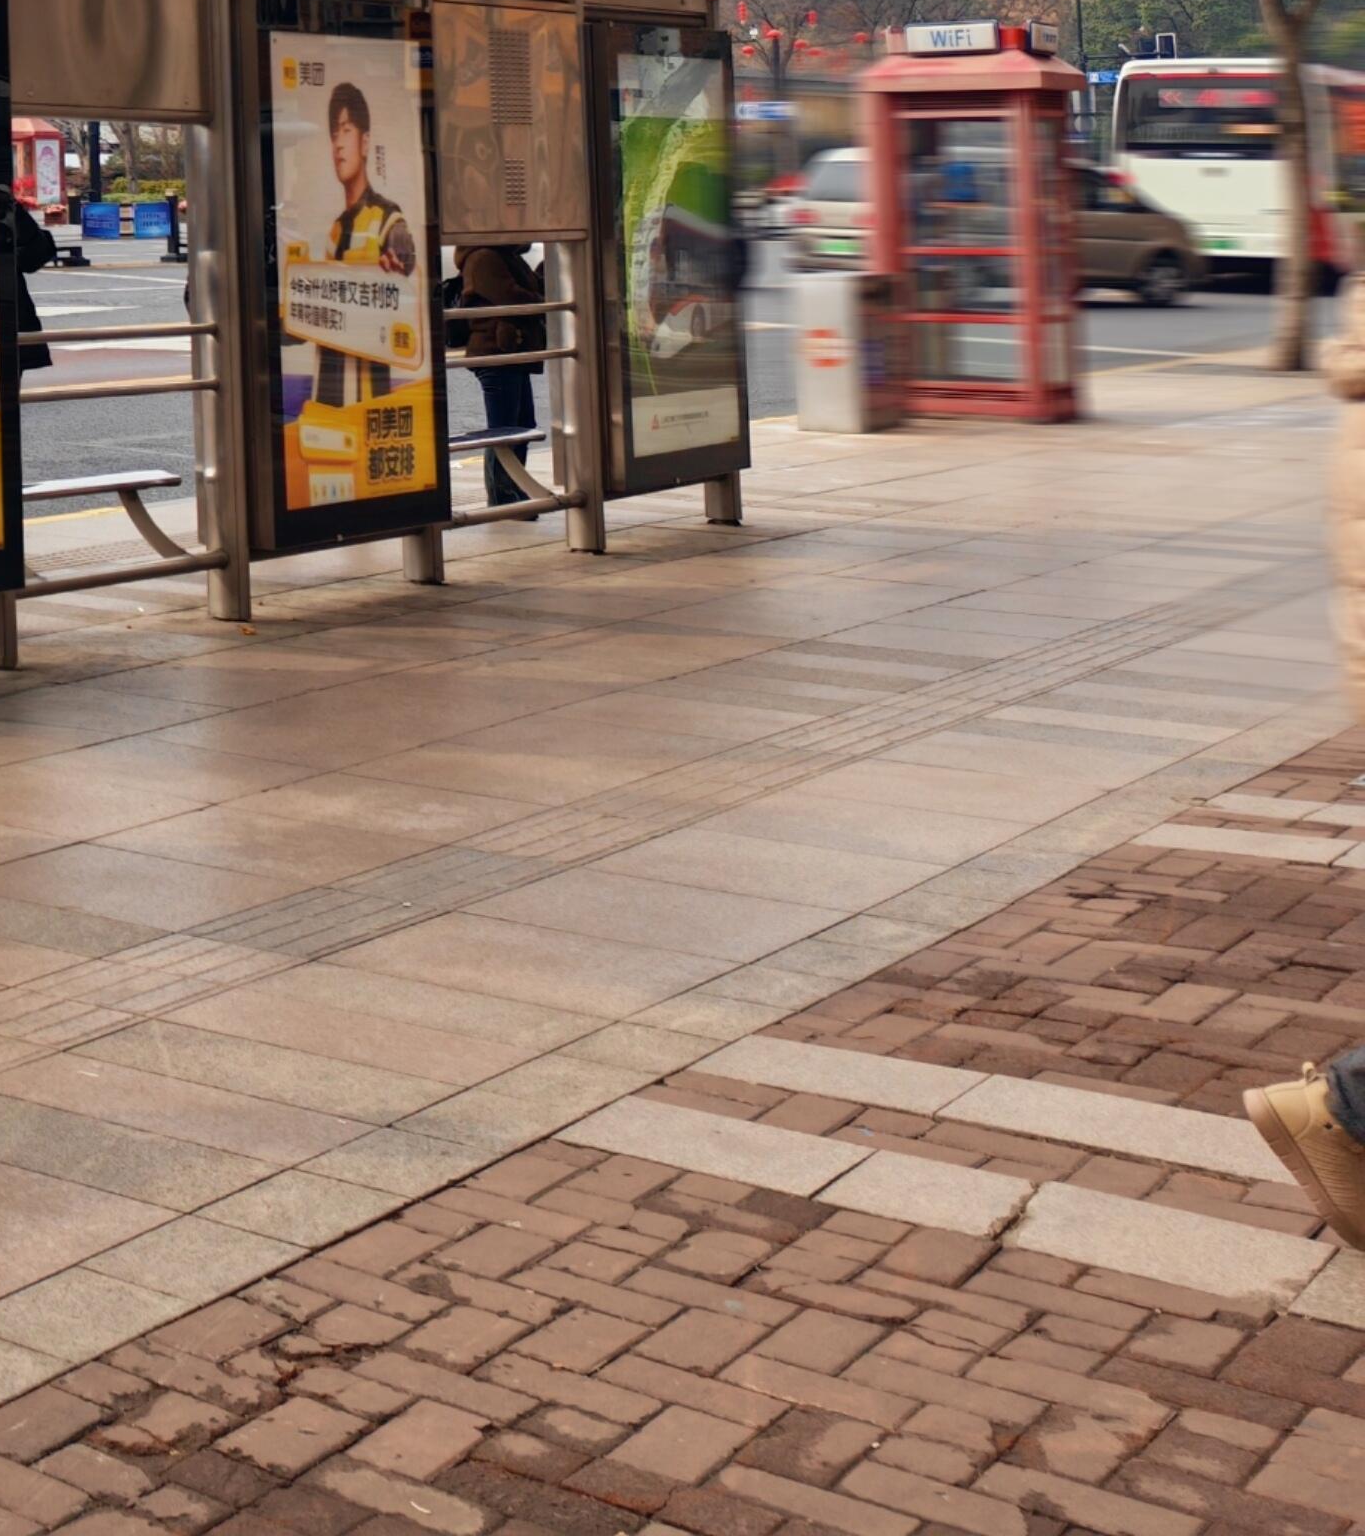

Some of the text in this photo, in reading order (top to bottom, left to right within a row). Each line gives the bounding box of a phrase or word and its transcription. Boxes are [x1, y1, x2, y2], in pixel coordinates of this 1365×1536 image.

[930, 29, 972, 47] WiFi
[300, 62, 325, 86] 美团
[366, 406, 413, 440] 问美团
[368, 445, 415, 480] 都安排
